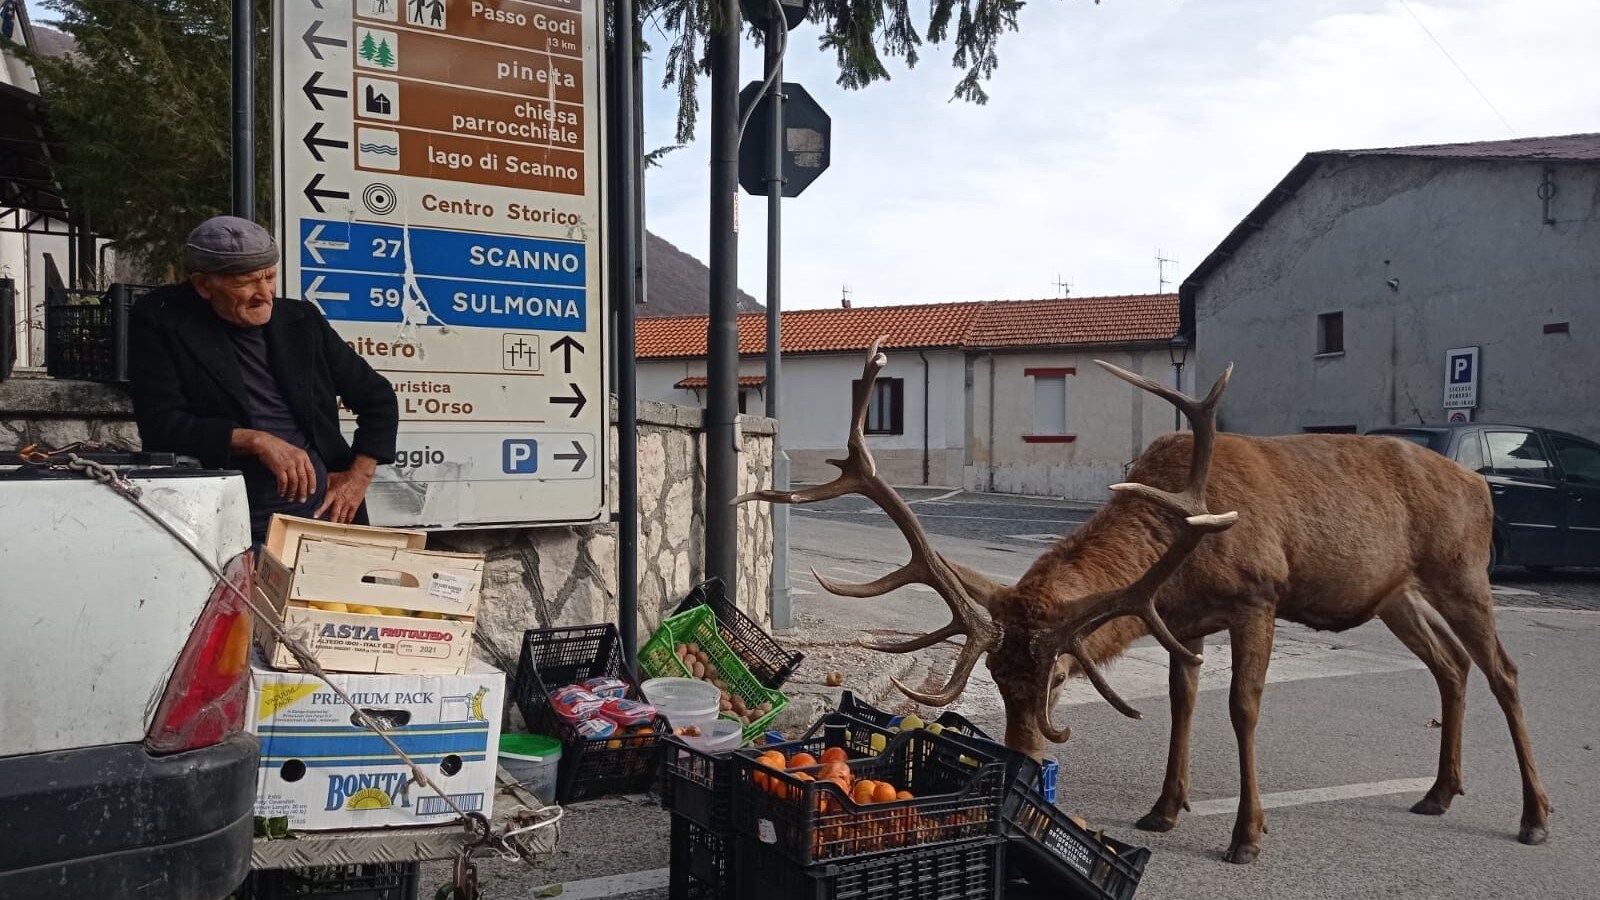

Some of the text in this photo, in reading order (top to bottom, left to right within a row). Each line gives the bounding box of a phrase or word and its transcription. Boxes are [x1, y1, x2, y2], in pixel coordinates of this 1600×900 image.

[471, 1, 576, 35] Passo Godi
[548, 37, 576, 50] 13 km
[497, 60, 575, 88] pineta
[514, 102, 578, 126] chiesa
[452, 113, 578, 144] parrocchiale
[428, 146, 578, 180] lago di Scanno
[422, 194, 578, 226] Centro Storico
[371, 238, 579, 273] 27 SCANNO
[369, 288, 580, 318] 59 SULMONA
[1455, 358, 1468, 380] P
[405, 398, 473, 414] L'Orso
[510, 443, 531, 470] P
[319, 622, 380, 641] ASTA
[419, 645, 437, 653] 2021
[312, 692, 435, 705] PREMIUM PACK
[324, 772, 410, 811] BONITA
